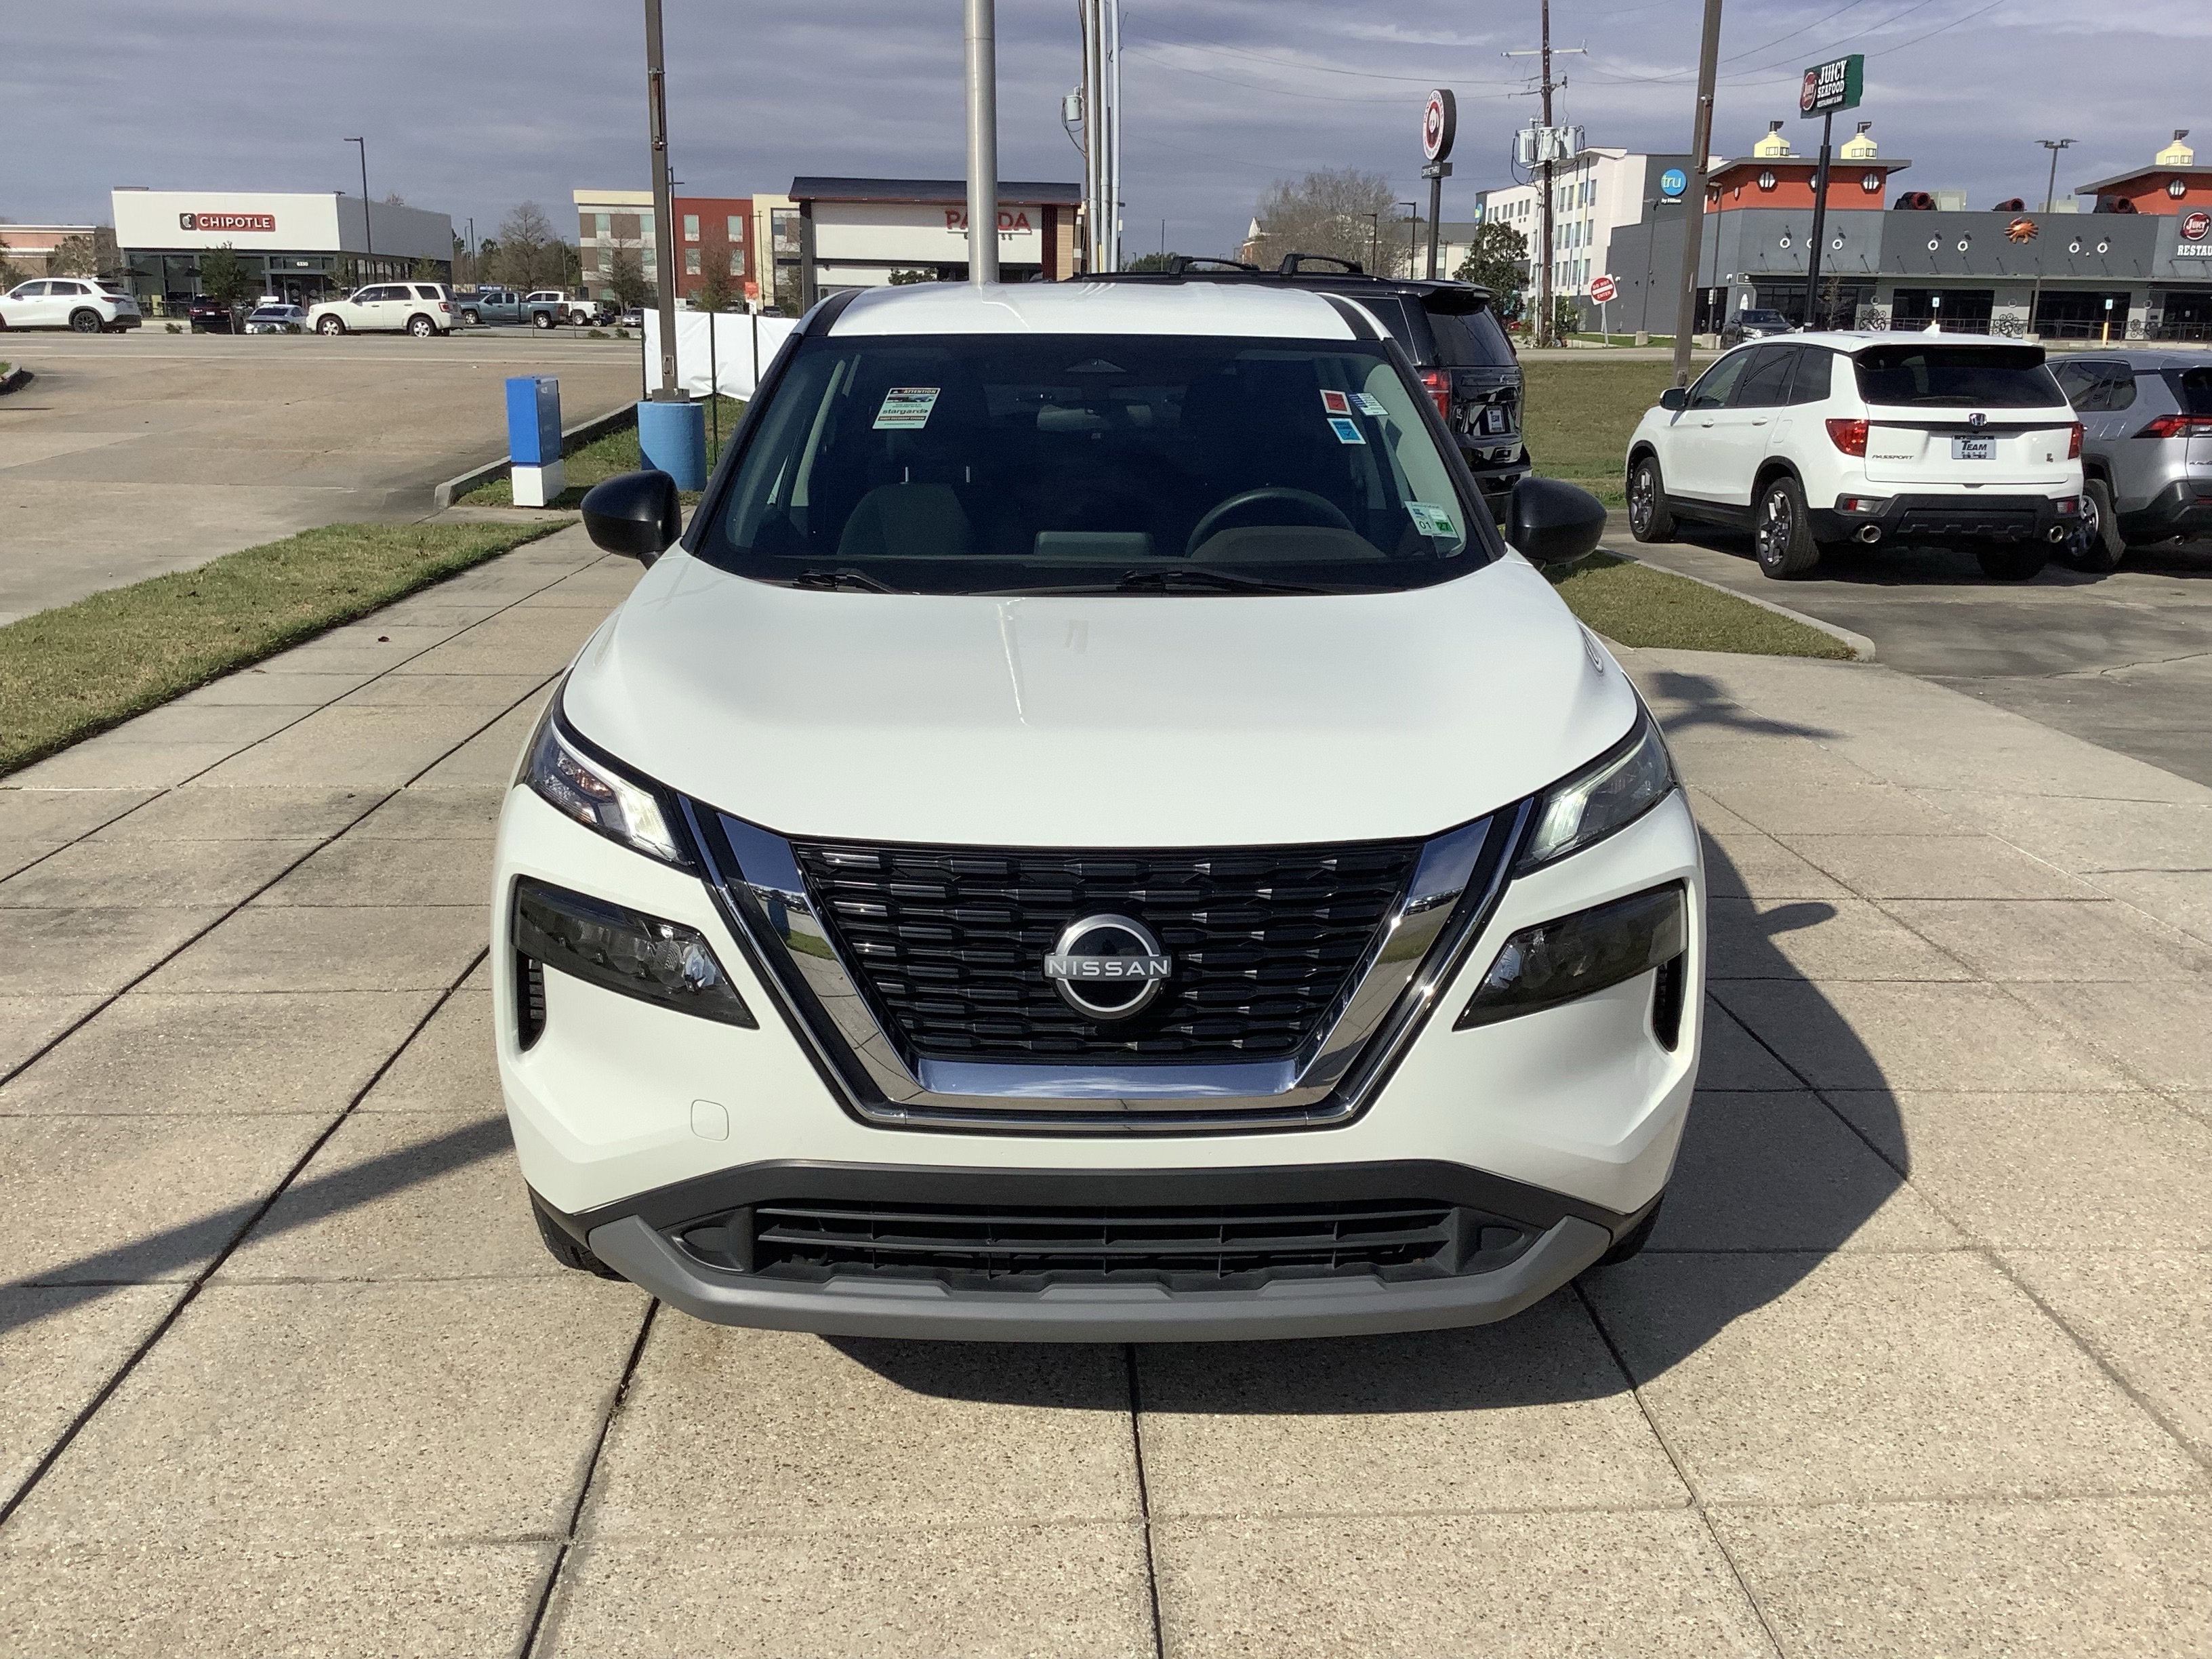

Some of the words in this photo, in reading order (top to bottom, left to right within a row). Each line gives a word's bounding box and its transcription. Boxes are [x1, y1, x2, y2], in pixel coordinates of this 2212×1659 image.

[1818, 60, 1847, 85] JUICY
[1818, 80, 1845, 98] SEAFOOD
[1662, 175, 1681, 188] tru
[200, 216, 270, 228] CHIPOTLE
[945, 211, 1031, 231] PDA
[1962, 441, 1987, 451] TEAM
[1419, 521, 1431, 529] 01
[1437, 522, 1450, 531] 27
[1049, 960, 1168, 976] NISSAN
